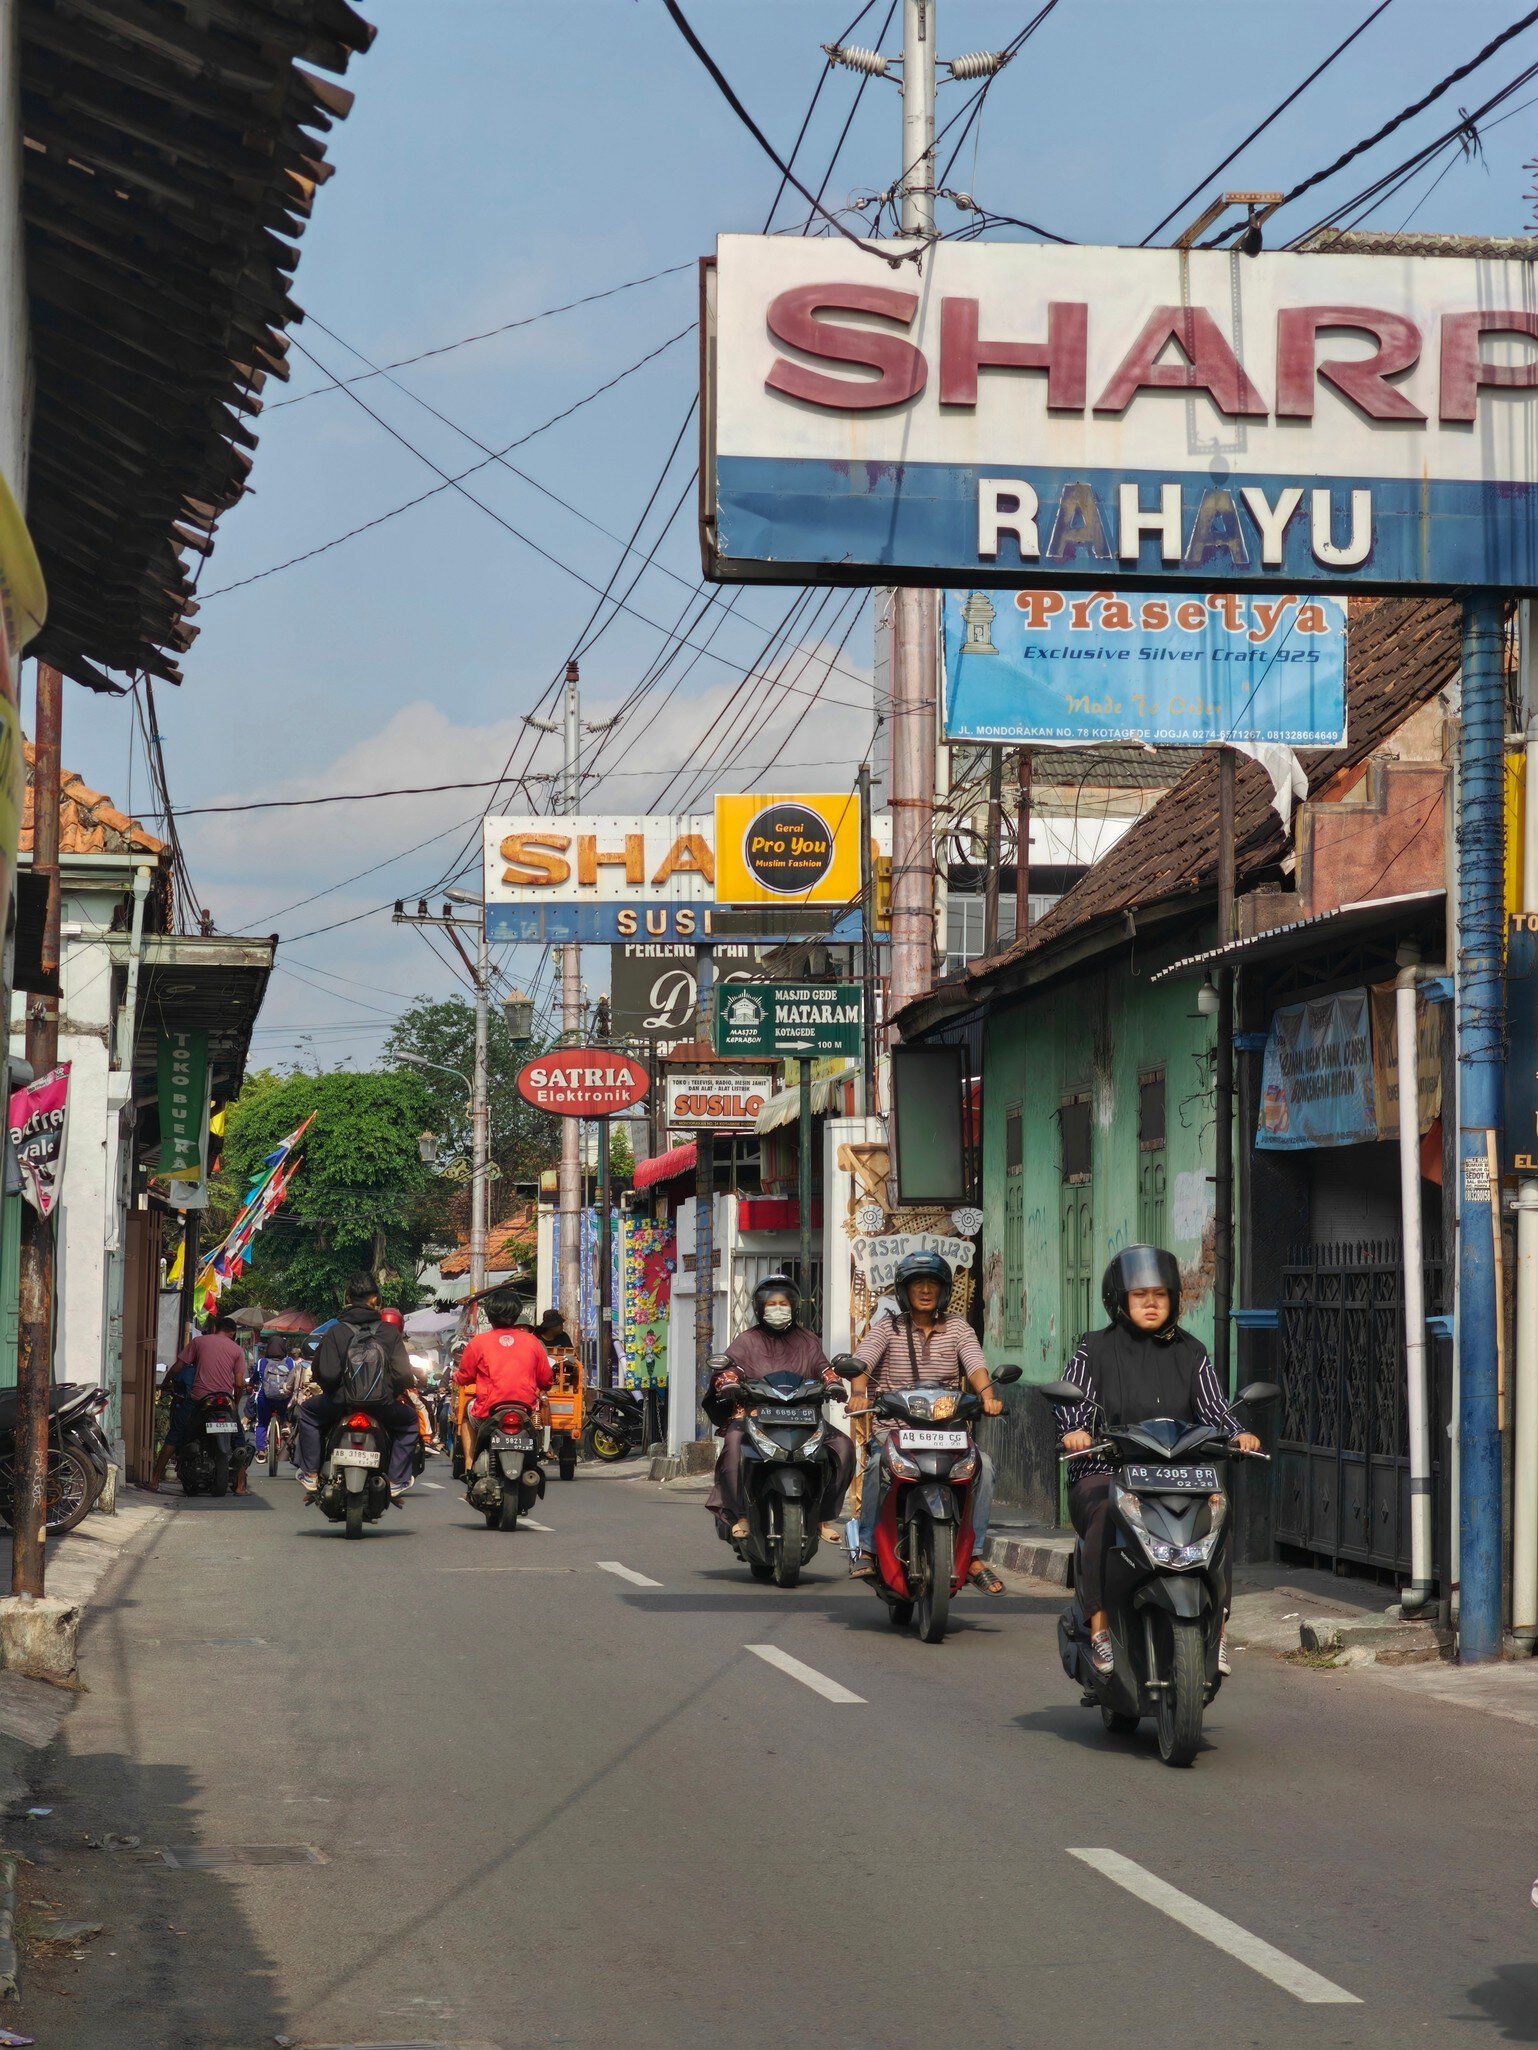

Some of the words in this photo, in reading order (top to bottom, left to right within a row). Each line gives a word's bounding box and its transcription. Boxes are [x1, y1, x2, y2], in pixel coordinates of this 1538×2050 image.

[765, 283, 1538, 424] SHARP
[978, 478, 1373, 568] RAHAYU
[1014, 589, 1333, 645] Prasetya
[1023, 646, 1130, 662] Exclusive
[1137, 647, 1205, 663] Silver
[1211, 648, 1267, 664] Craft
[1275, 649, 1321, 664] 925
[1065, 695, 1122, 717] Made
[958, 726, 973, 736] JL.
[976, 727, 1053, 738] MONDORAKAN
[1056, 728, 1074, 738] NO.
[1077, 729, 1089, 738] 78
[1092, 729, 1150, 739] KOTAGEDE
[1153, 730, 1190, 740] JOGJA
[775, 823, 804, 833] Gerai
[751, 836, 786, 853] Pro
[791, 836, 827, 856] You
[499, 832, 715, 886] SHA
[755, 859, 786, 868] Muslim
[788, 859, 822, 868] Fashion
[775, 990, 810, 1001] MASJID
[812, 990, 837, 1001] GEDE
[774, 1005, 859, 1024] MATARAM
[775, 1028, 816, 1037] KOTAGEDE
[817, 1041, 832, 1049] 100
[834, 1041, 843, 1049] M
[171, 1032, 191, 1086] TOKO
[530, 1068, 636, 1089] SATRIA
[537, 1089, 631, 1102] Elektronik
[673, 1094, 765, 1117] SUSILO
[853, 1237, 910, 1260] Pasar
[903, 1433, 915, 1441] AB
[1131, 1468, 1148, 1477] AB
[1156, 1469, 1188, 1479] 4305
[1195, 1470, 1213, 1479] BR
